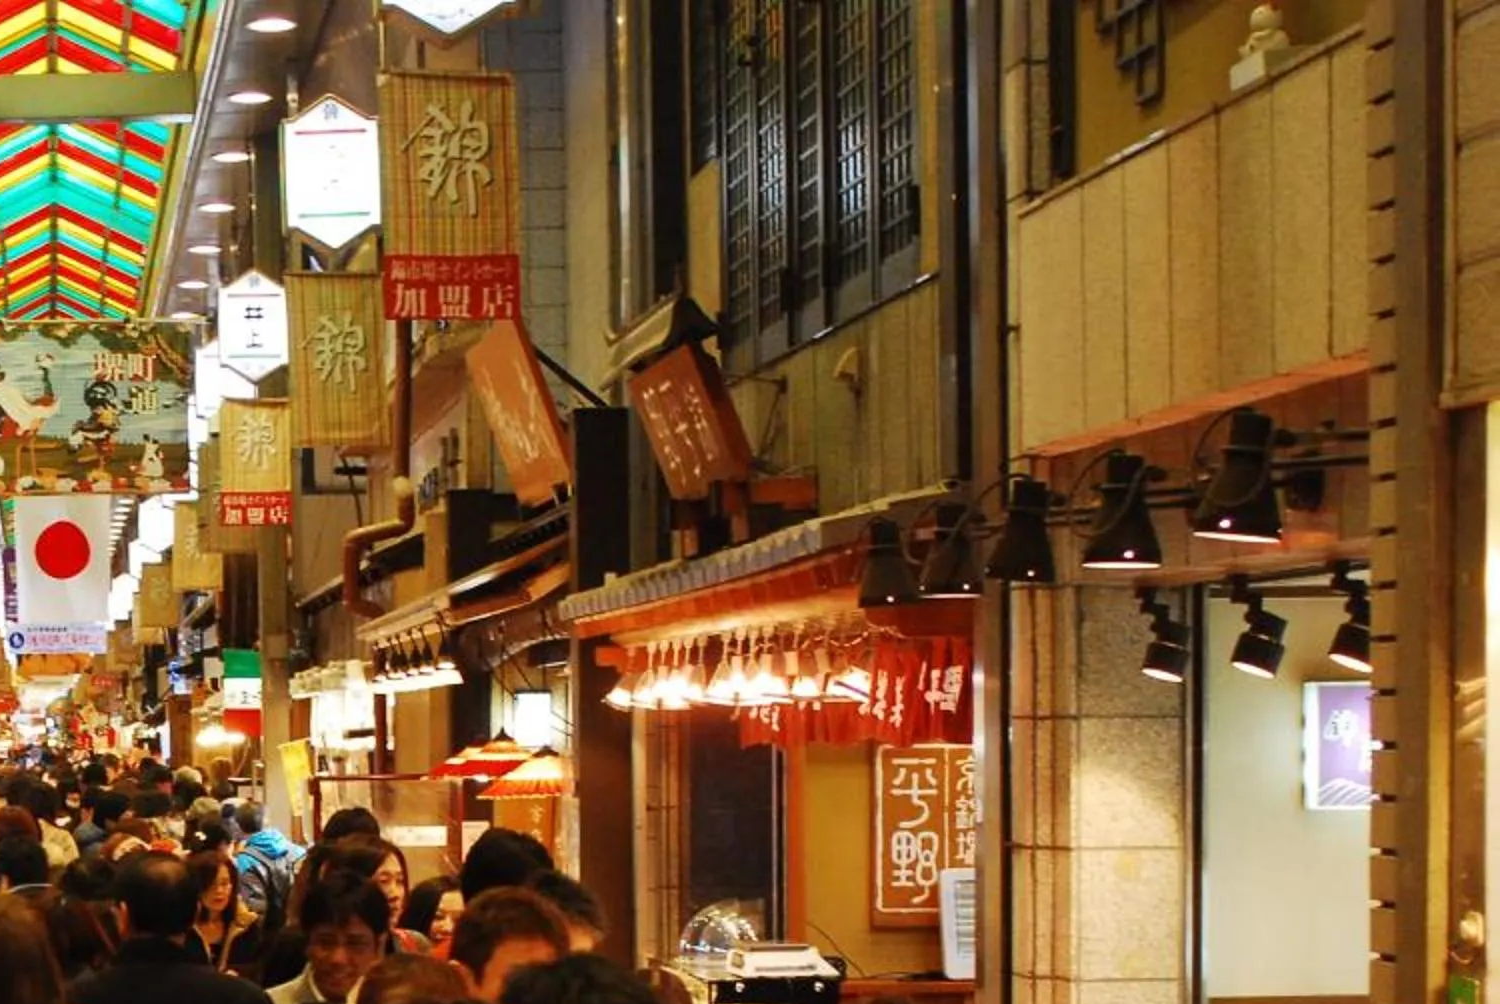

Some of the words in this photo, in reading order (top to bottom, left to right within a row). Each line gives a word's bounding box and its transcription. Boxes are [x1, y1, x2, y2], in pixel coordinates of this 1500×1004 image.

[403, 100, 493, 218] 錦
[394, 283, 515, 318] 加盟店
[244, 305, 264, 349] 井上
